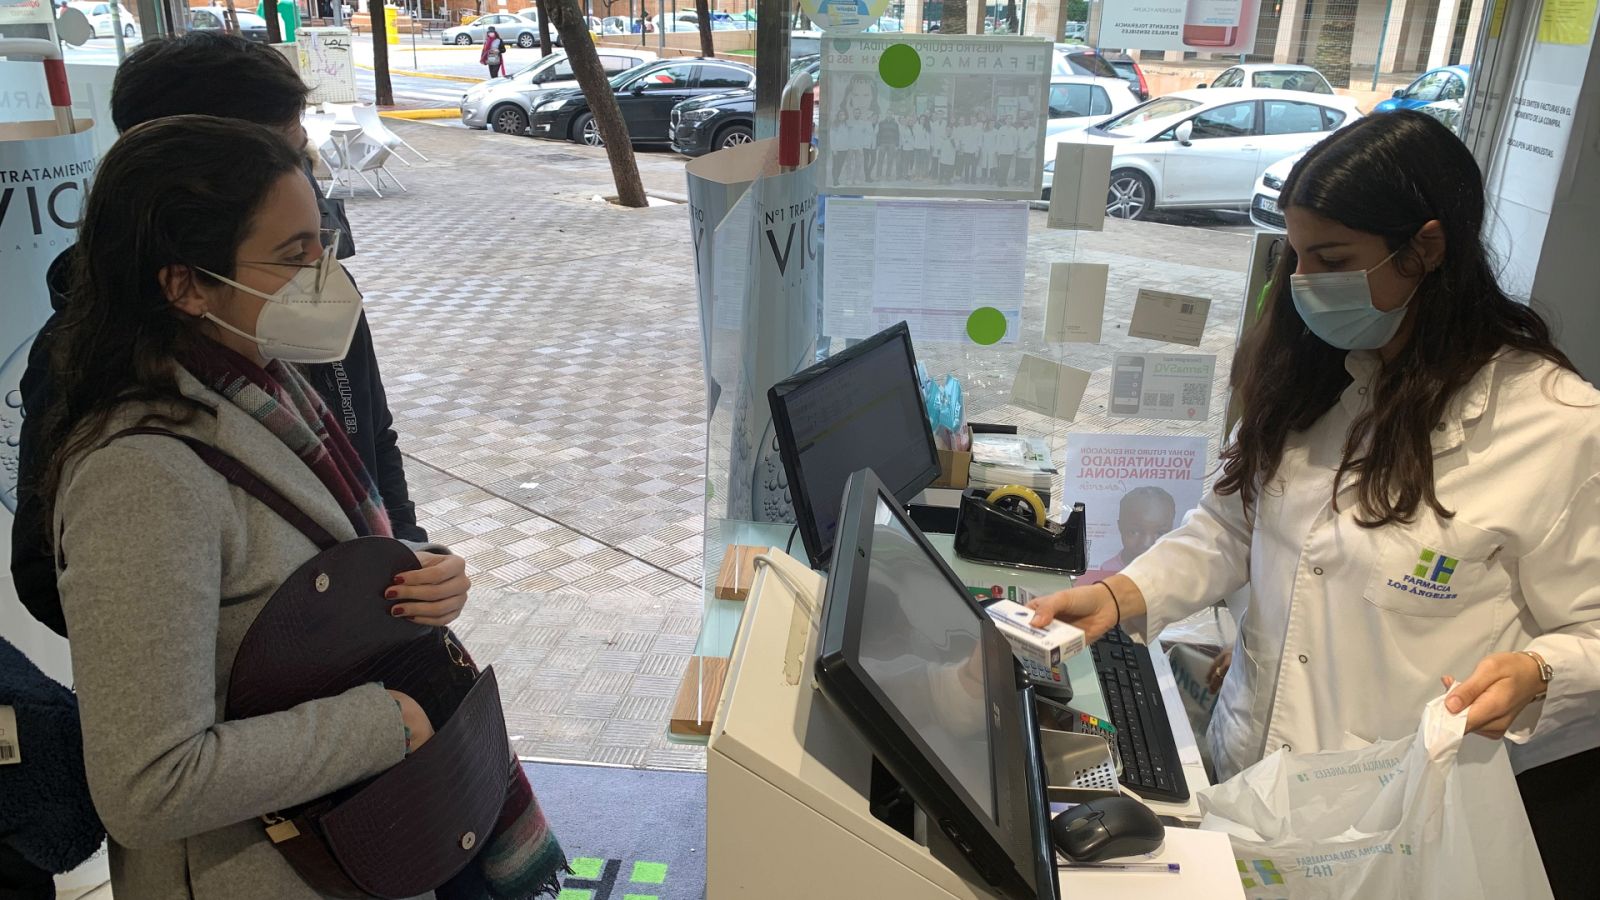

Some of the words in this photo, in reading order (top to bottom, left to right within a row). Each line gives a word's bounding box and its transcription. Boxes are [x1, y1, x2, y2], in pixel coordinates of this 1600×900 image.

[1387, 579, 1408, 591] LOS
[1403, 574, 1451, 592] FARMACIA
[1296, 853, 1340, 866] FARMACIA
[1340, 849, 1357, 860] LOS
